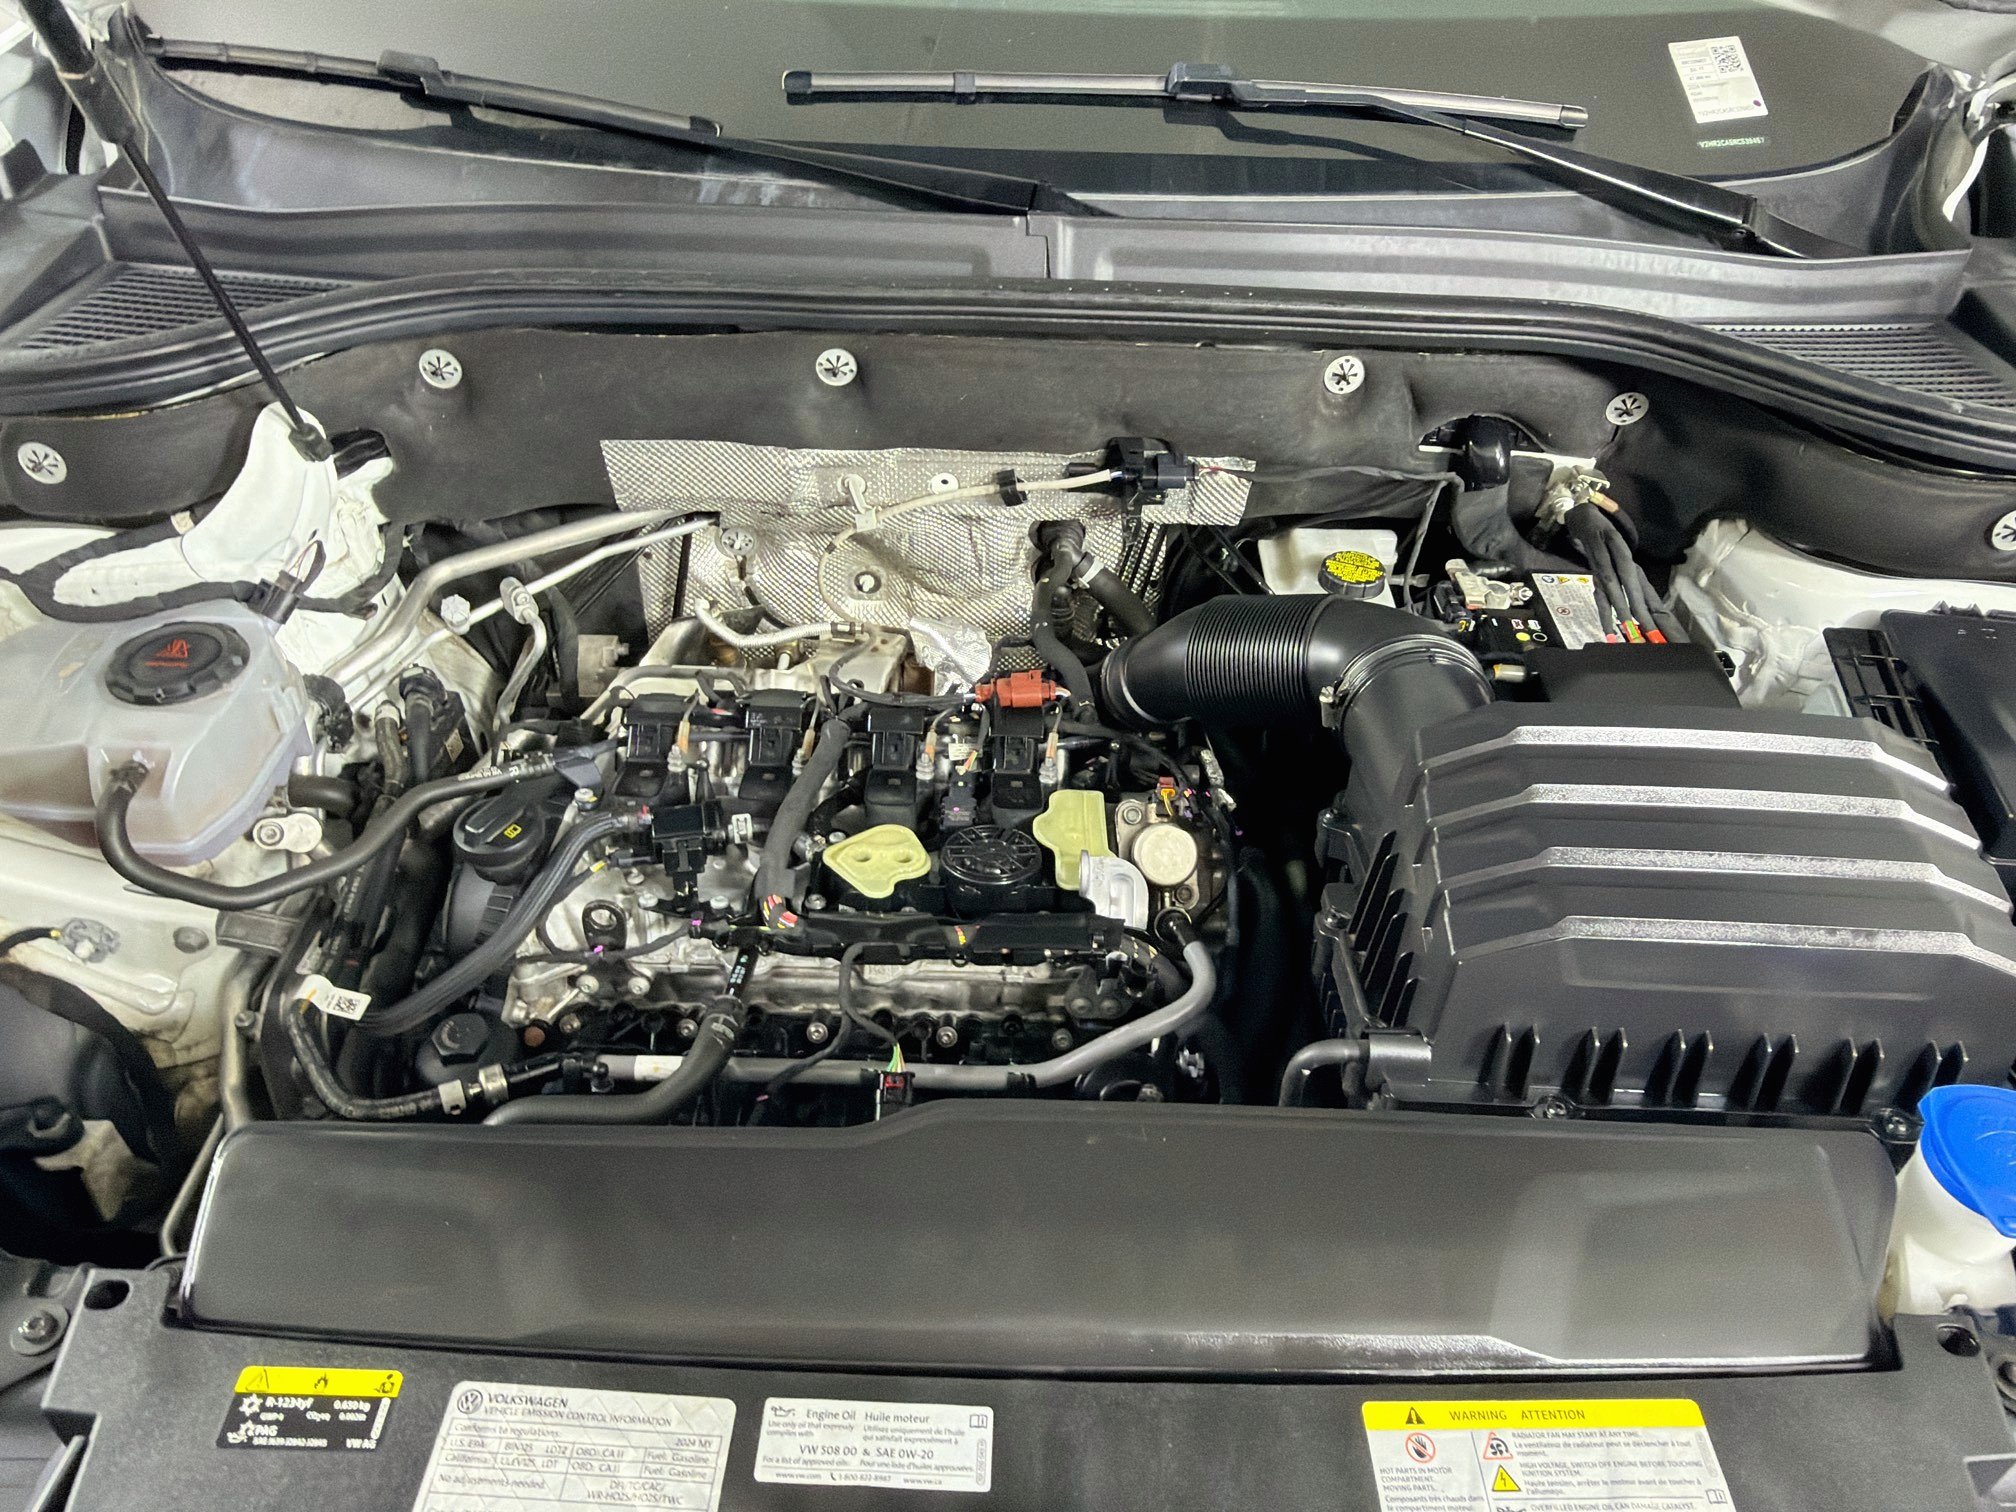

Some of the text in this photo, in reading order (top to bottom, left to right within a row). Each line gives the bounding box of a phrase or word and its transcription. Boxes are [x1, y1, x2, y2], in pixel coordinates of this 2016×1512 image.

[266, 1397, 314, 1410] R-1234yf
[488, 1392, 569, 1409] VOLKSWAGEN
[484, 1405, 672, 1428] VEHICLE EMISSION CONTROL INFORMATION
[806, 1408, 856, 1422] Engine Oil
[865, 1412, 930, 1424] Huile moteur
[1450, 1409, 1586, 1422] WARNING ATTENTION
[254, 1424, 278, 1436] PAG
[768, 1420, 782, 1428] Use
[783, 1422, 796, 1430] only
[863, 1424, 888, 1434] Utilisez
[890, 1426, 932, 1436] uniquement
[934, 1428, 942, 1436] de
[346, 1438, 377, 1449] VW AG
[699, 1439, 713, 1449] MY
[862, 1434, 874, 1442] qui
[875, 1435, 902, 1444] satisfait
[1677, 1440, 1692, 1448] tout
[800, 1444, 934, 1460] VW 508 00 & SAE 0W-20
[672, 1452, 710, 1464] Gasoline
[762, 1455, 774, 1463] For
[782, 1456, 792, 1464] list
[793, 1456, 800, 1464] of
[802, 1458, 835, 1467] approved
[860, 1460, 875, 1468] Pour
[892, 1462, 905, 1470] liste
[1640, 1460, 1667, 1468] BEFORE
[1668, 1460, 1704, 1468] TOUCHING
[668, 1466, 708, 1480] Gasoline
[1428, 1466, 1452, 1474] MOTOR
[1383, 1484, 1412, 1492] MOVING
[1385, 1495, 1427, 1504] Composants
[1442, 1494, 1466, 1503] chauds
[1468, 1494, 1484, 1502] dans
[1395, 1504, 1446, 1512] compartiment
[1531, 1504, 1573, 1512] OVERFILLED
[1574, 1504, 1600, 1512] ENGINE
[1631, 1502, 1660, 1510] DAMAGE
